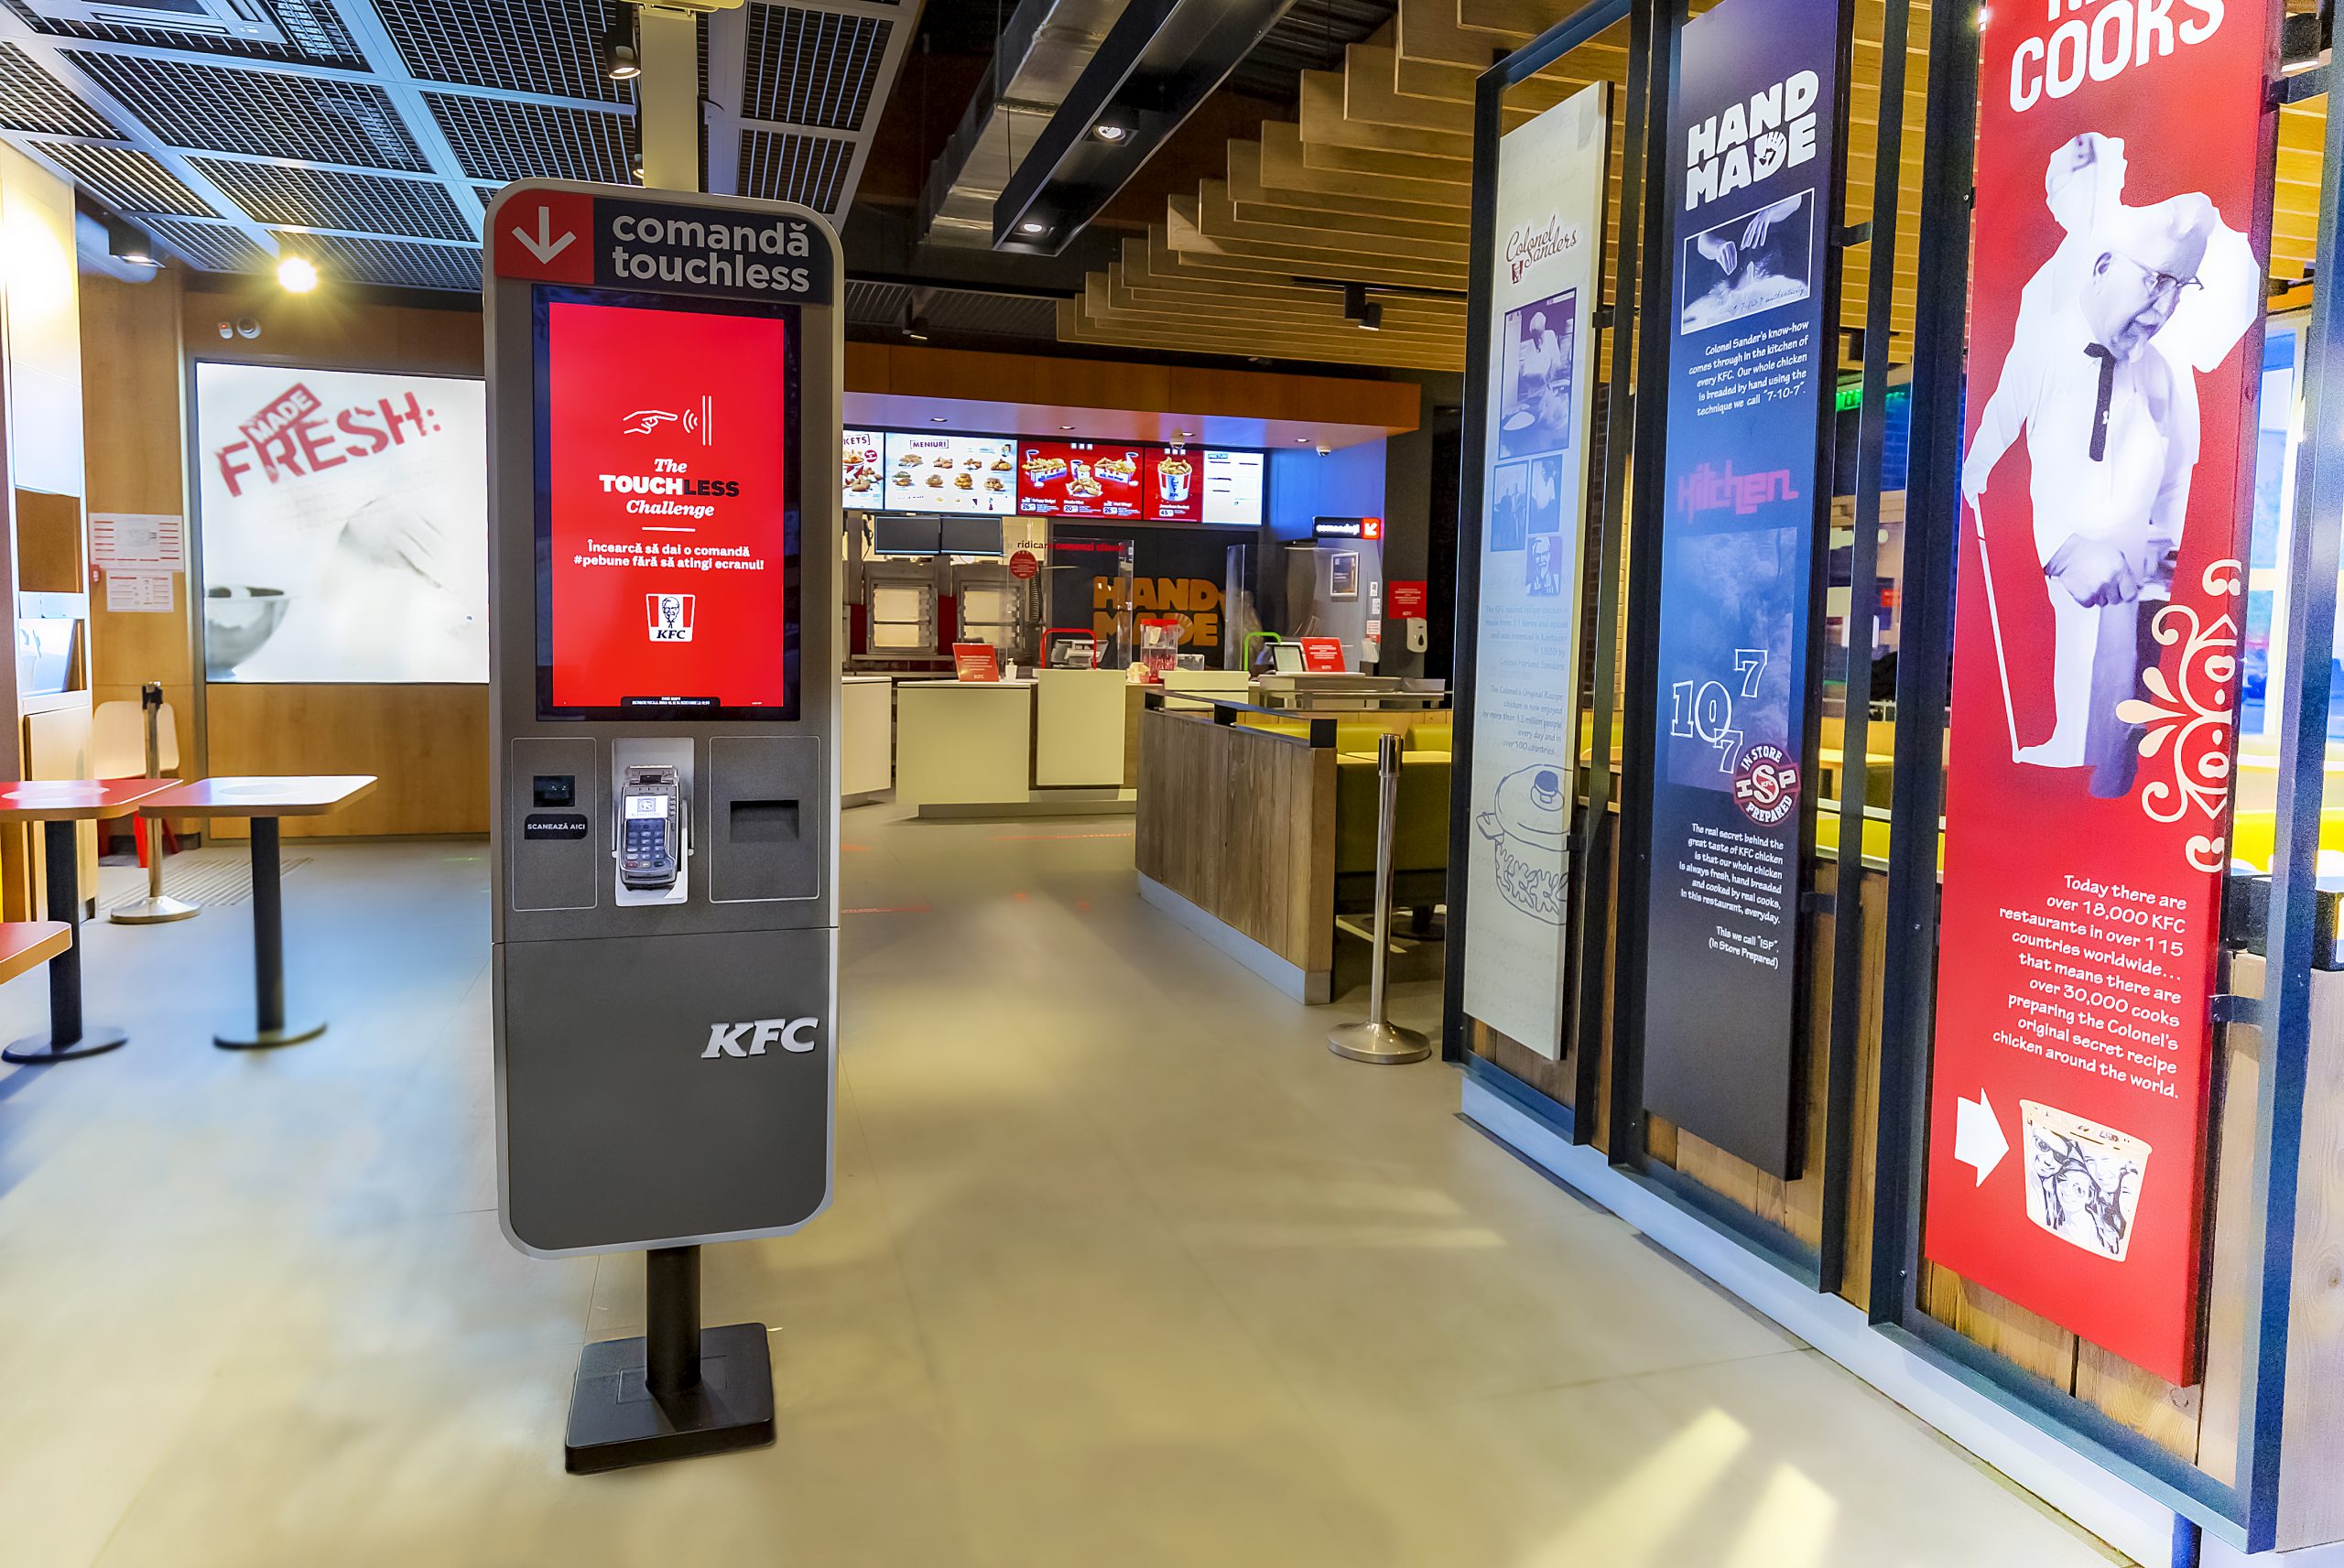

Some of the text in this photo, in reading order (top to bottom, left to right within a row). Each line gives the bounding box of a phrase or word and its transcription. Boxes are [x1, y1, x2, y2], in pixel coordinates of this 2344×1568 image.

[2010, 0, 2224, 112] COOKS
[1687, 70, 1818, 168] HAND
[1686, 113, 1816, 211] MADE
[613, 215, 809, 257] comandă
[1506, 214, 1555, 262] Colonel
[1525, 226, 1576, 267] Sanders
[613, 246, 809, 293] touchless
[1688, 335, 1808, 374] comes through in the kitchen of
[1706, 321, 1809, 355] Colonel Sander's know-how
[1697, 353, 1807, 387] every KFC. Our whole chicken
[1699, 369, 1807, 401] is breaded by hand using the
[247, 388, 314, 442] MADE
[1697, 401, 1732, 416] technique
[1734, 399, 1743, 408] we
[1746, 394, 1760, 406] call
[843, 437, 867, 445] KETS
[655, 459, 687, 473] The
[599, 475, 739, 497] TOUCHLESS
[626, 500, 714, 518] Challenge
[574, 555, 765, 570] #pebune fără să atingi ecranul!
[588, 539, 643, 554] Încearcă
[646, 544, 659, 555] să
[662, 544, 680, 555] dai
[694, 546, 750, 557] comandă
[1093, 577, 1220, 611] HAND
[657, 630, 685, 639] KFC
[1093, 611, 1218, 646] MADE
[1734, 649, 1768, 698] 7
[1671, 680, 1732, 743] 10
[1714, 729, 1742, 773] 7
[1741, 746, 1782, 771] IN STORE
[1736, 764, 1796, 803] ISP
[527, 822, 568, 830] SCANEAZĂ
[1746, 795, 1792, 822] PREPARED
[1688, 838, 1783, 865] great taste of KFC chicken
[1692, 823, 1784, 849] The real secret behind the
[1679, 861, 1782, 893] is always fresh, hand breaded
[1695, 851, 1701, 860] is
[1702, 854, 1718, 864] that
[1733, 860, 1753, 872] whole
[1754, 865, 1782, 879] chicken
[1681, 889, 1780, 925] in this restaurant, everyday.
[1692, 880, 1781, 910] and cooked by real cooks,
[2064, 875, 2187, 910] Today there are
[2000, 908, 2184, 957] restaurants in over 115
[2046, 897, 2186, 934] over 18,000 KFC
[1709, 938, 1778, 969] (In Store Prepared)
[1717, 926, 1731, 937] This
[1732, 933, 1742, 941] we
[1743, 935, 1755, 946] call
[2012, 932, 2079, 956] countries
[2019, 953, 2181, 1004] that means there are
[2030, 979, 2179, 1027] over 30,000 cooks
[700, 1017, 819, 1059] KFC
[2008, 994, 2178, 1050] preparing the Colonel's
[1992, 1031, 2178, 1098] chicken around the world.
[2018, 1018, 2176, 1076] original secret recipe
